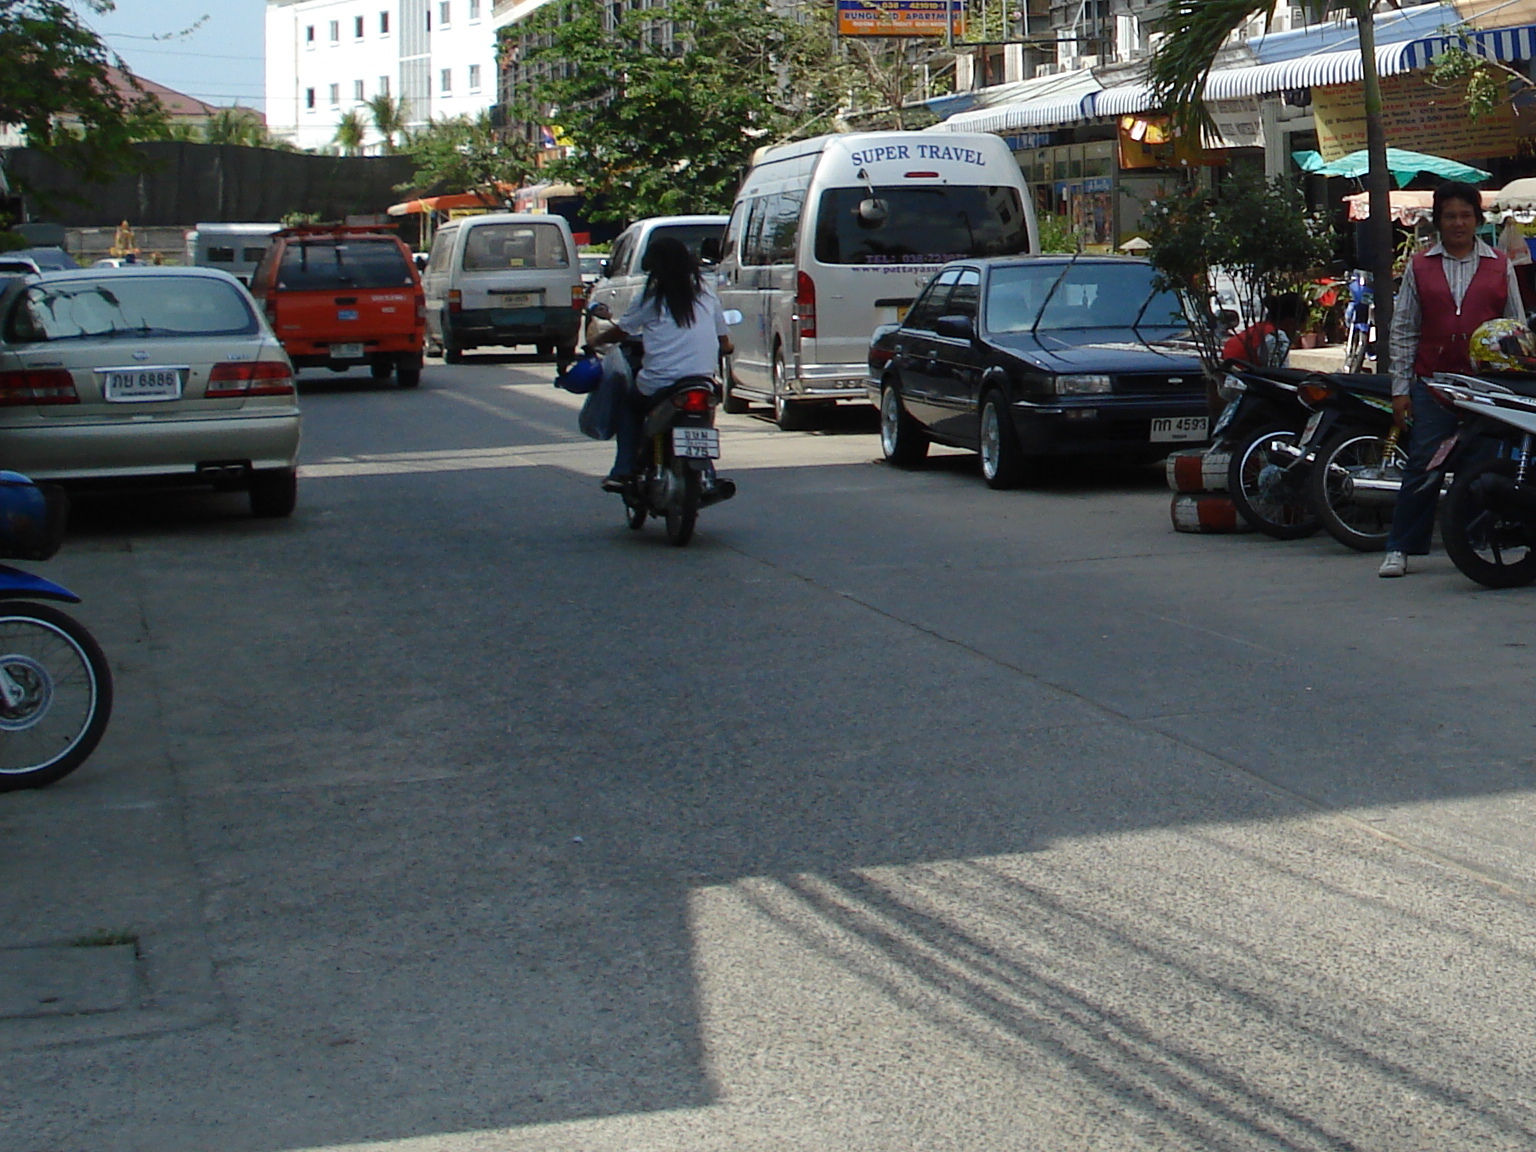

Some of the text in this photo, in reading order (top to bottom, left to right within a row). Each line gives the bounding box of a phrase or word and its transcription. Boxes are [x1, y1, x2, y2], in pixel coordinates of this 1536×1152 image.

[851, 144, 986, 166] SUPER TRAVEL
[1176, 418, 1207, 430] 4593
